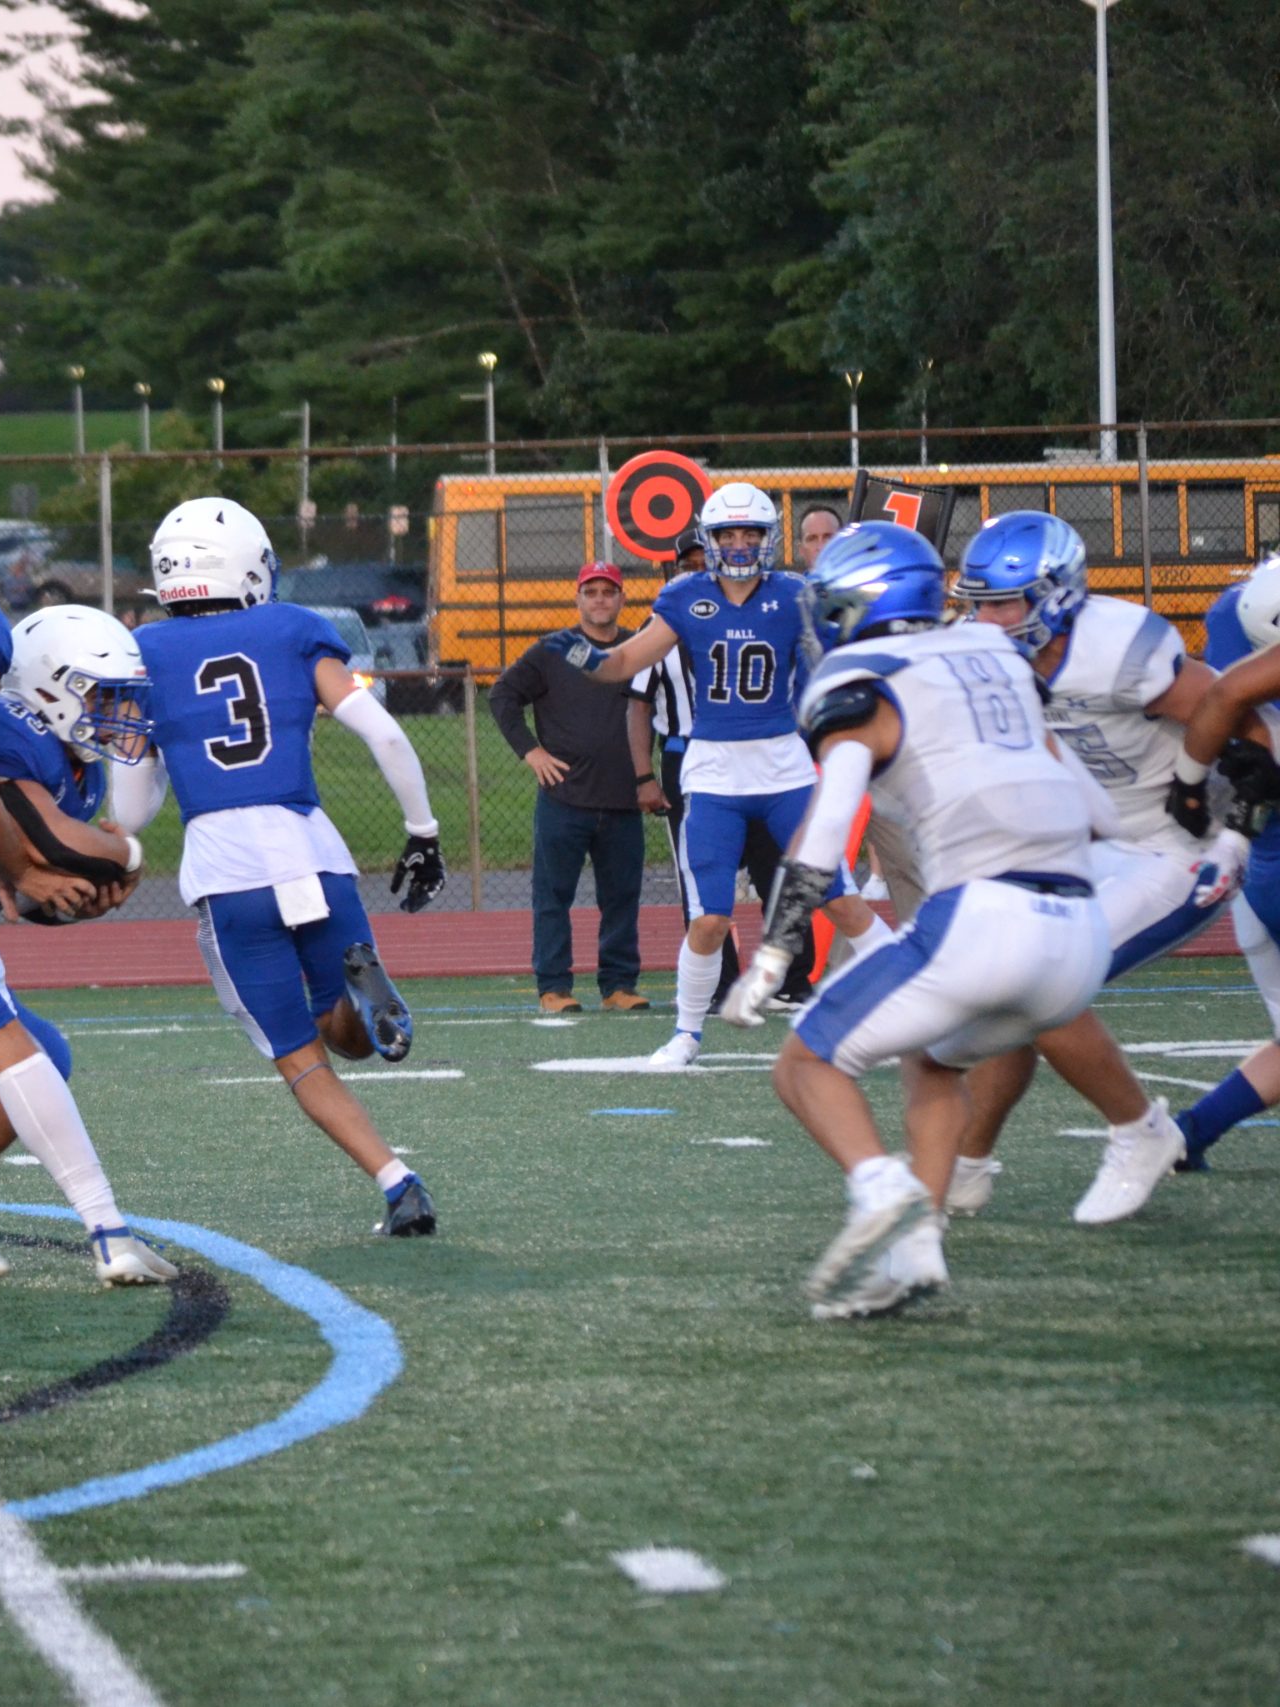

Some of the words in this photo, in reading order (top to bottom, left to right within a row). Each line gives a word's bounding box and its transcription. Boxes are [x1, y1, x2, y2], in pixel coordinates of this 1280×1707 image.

[883, 491, 923, 532] 1
[159, 584, 209, 601] Riddell
[726, 629, 756, 639] HALL
[707, 640, 777, 704] 10
[194, 652, 273, 771] 3
[939, 650, 1034, 751] 8
